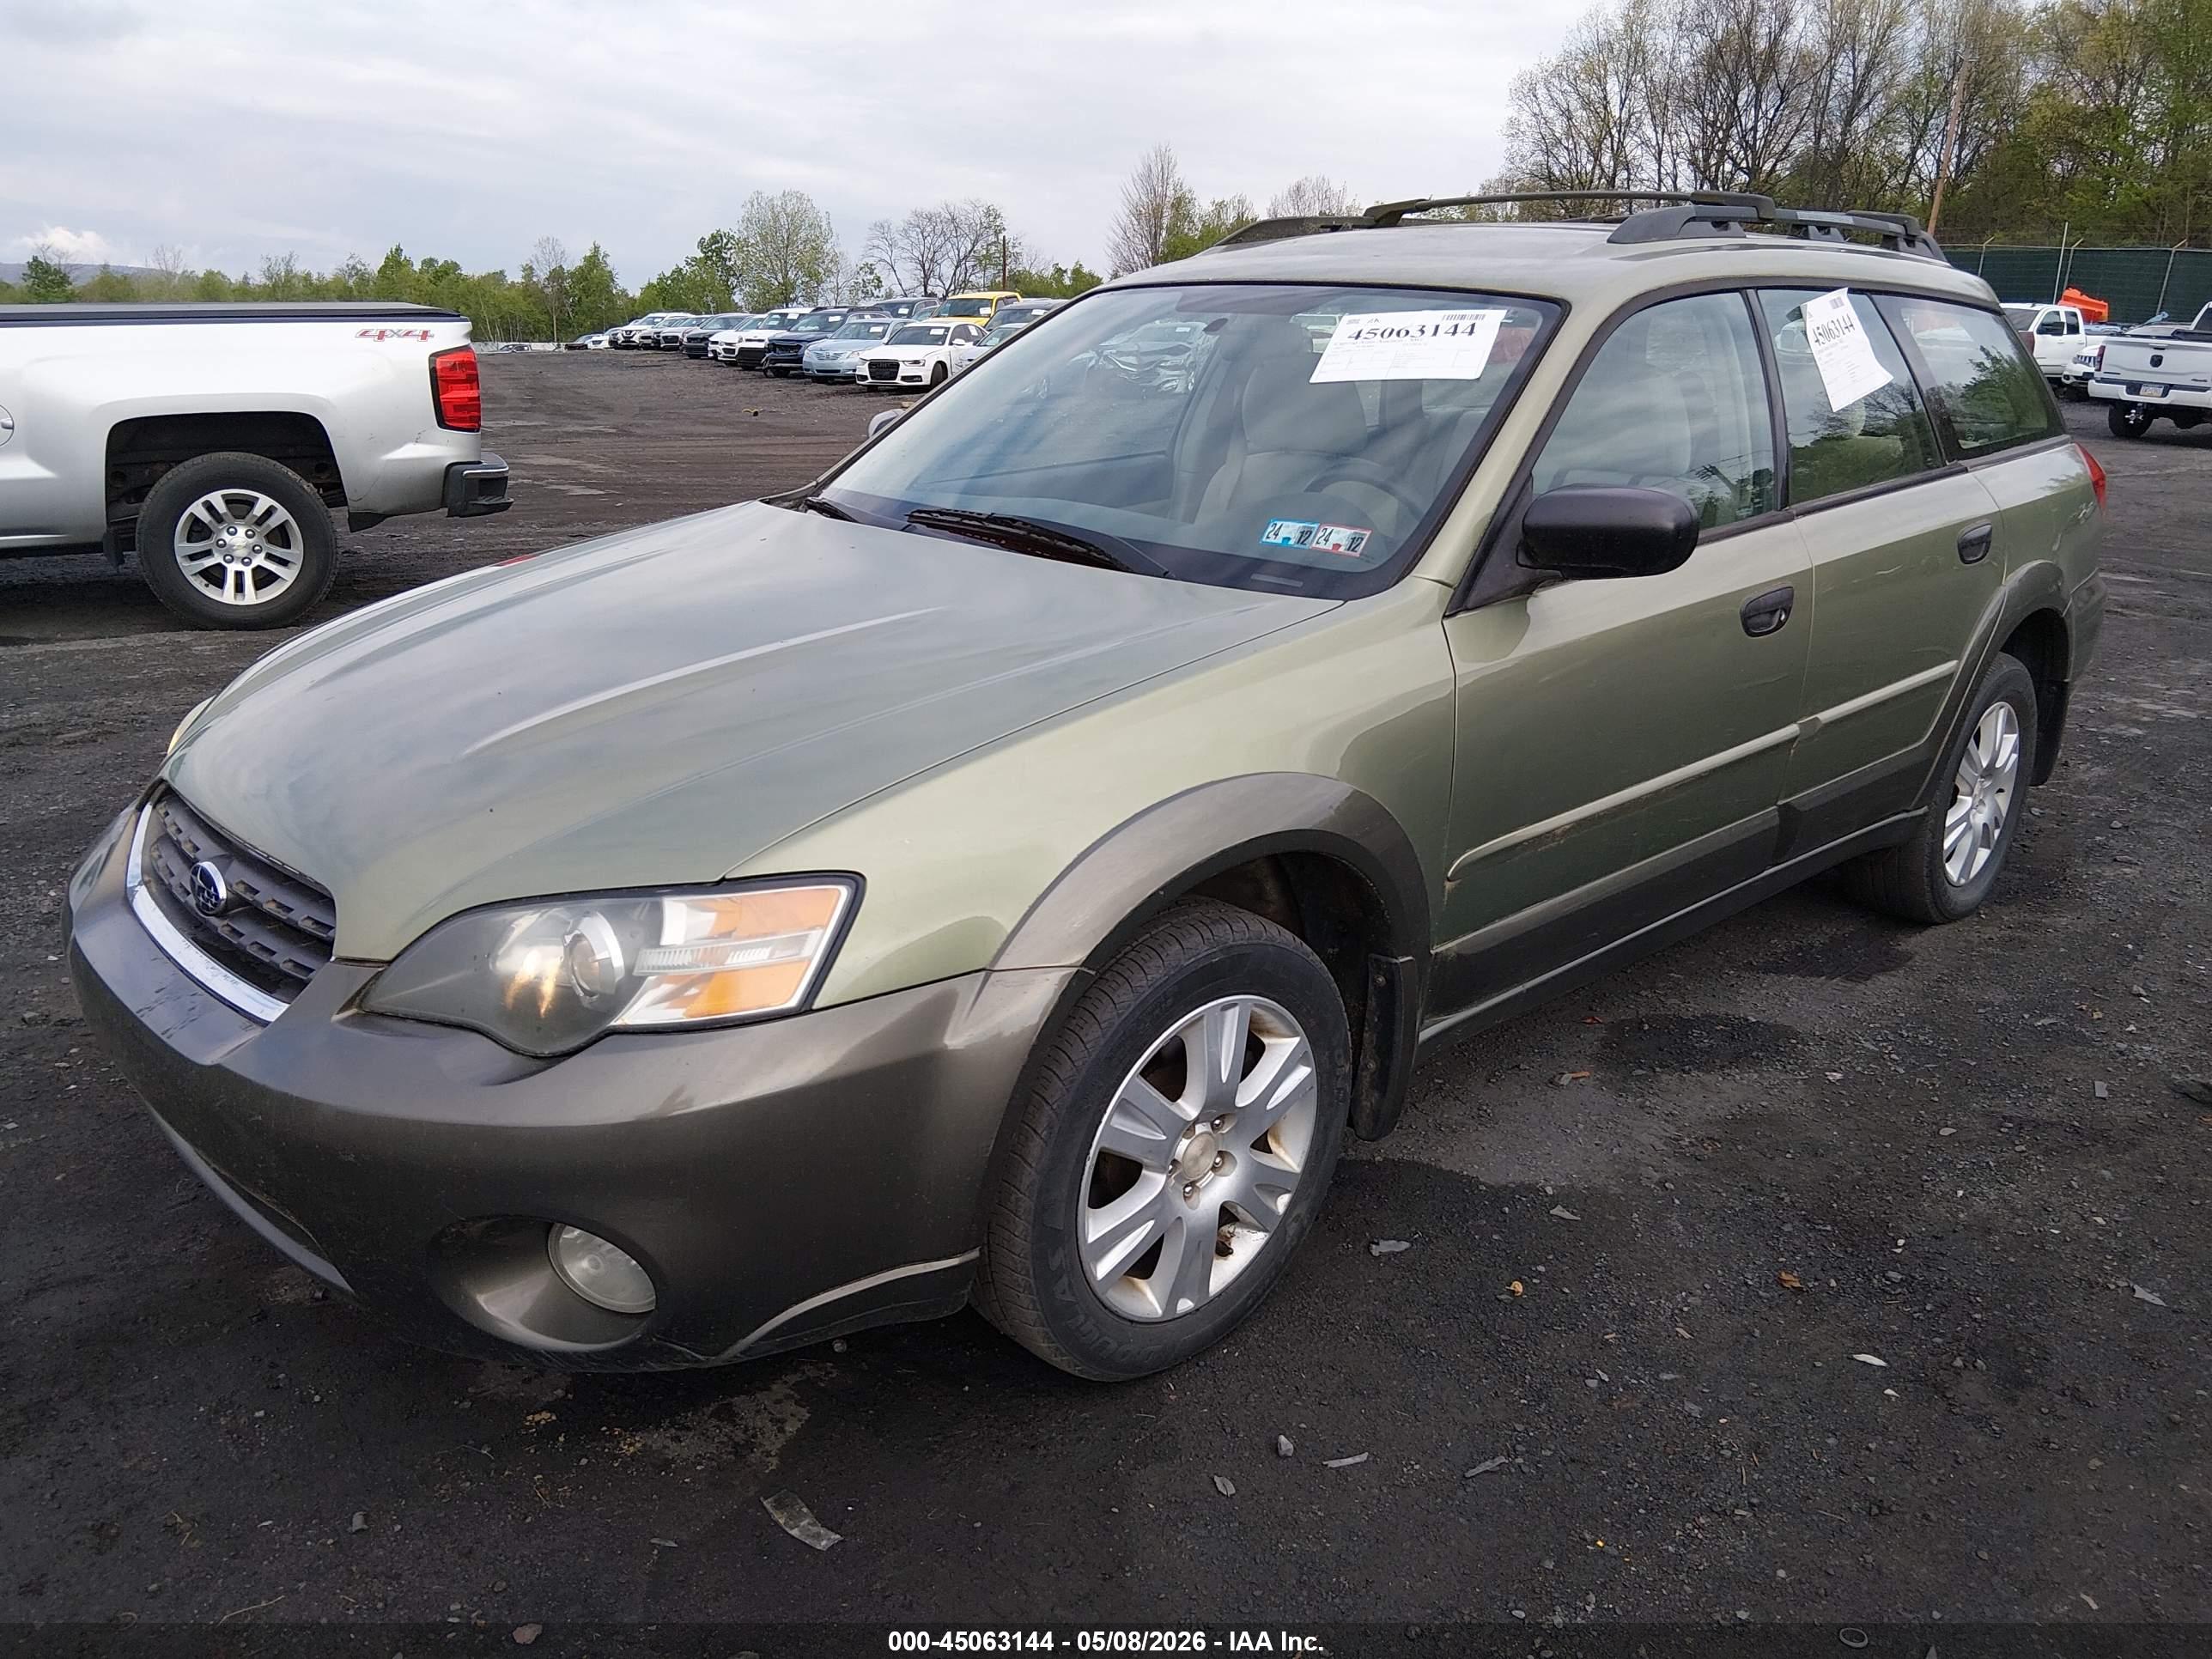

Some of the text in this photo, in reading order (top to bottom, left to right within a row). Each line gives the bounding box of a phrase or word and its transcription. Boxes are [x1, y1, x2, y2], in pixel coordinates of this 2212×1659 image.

[1346, 321, 1477, 341] 45063144
[1812, 313, 1856, 346] 45063144
[1266, 522, 1313, 546] 24 12
[1316, 527, 1365, 553] 24 12
